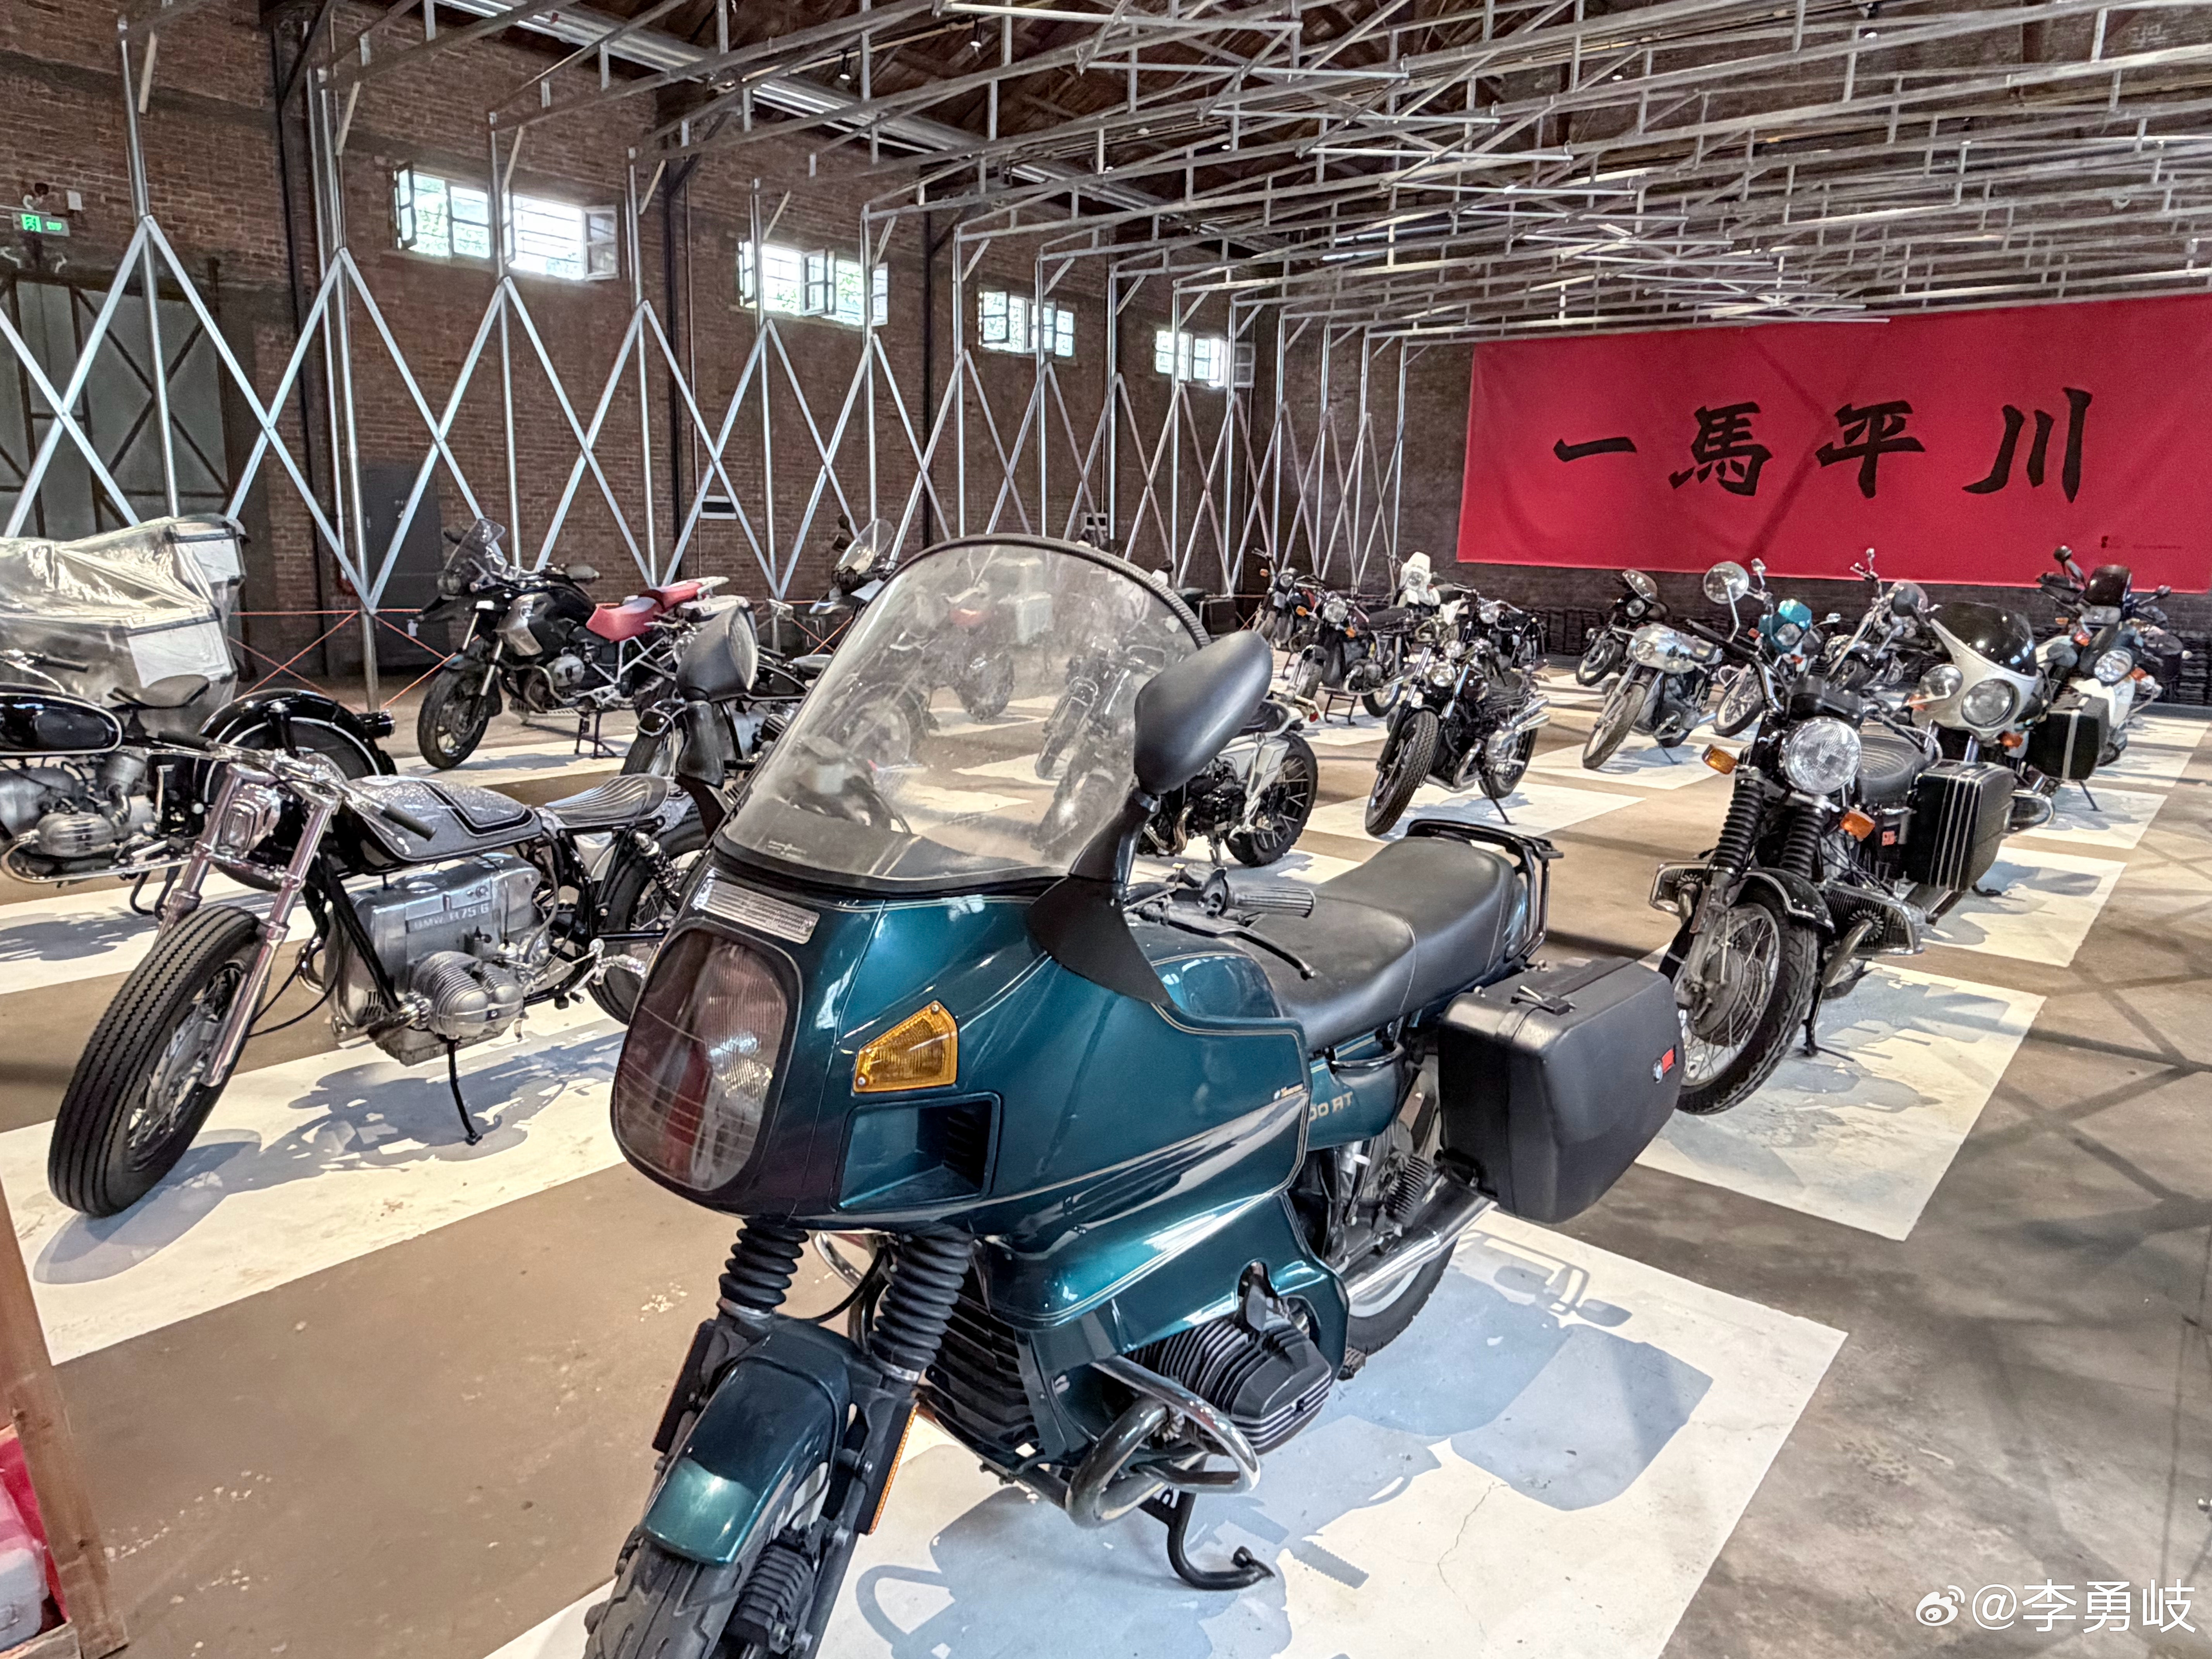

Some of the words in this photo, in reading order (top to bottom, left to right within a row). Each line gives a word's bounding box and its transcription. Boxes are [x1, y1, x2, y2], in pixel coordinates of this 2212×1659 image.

[1553, 387, 2093, 503] 一馬平川
[1331, 1091, 1353, 1113] RT
